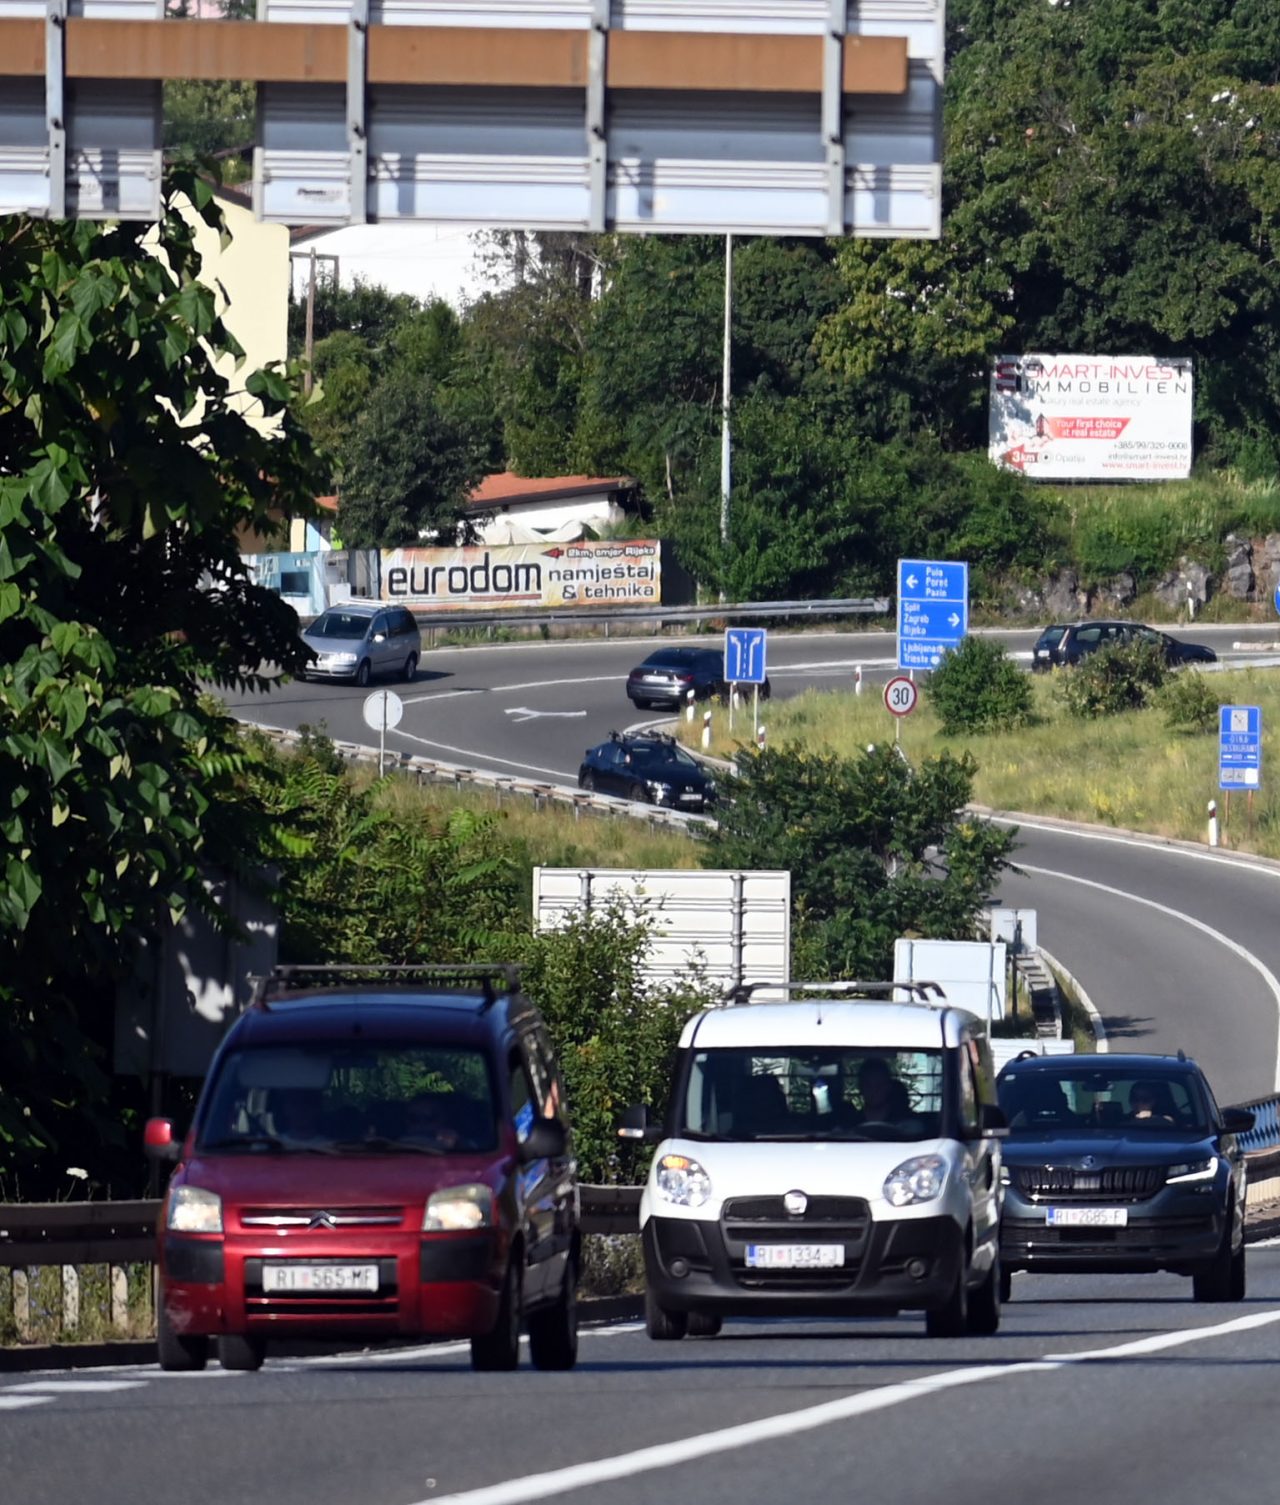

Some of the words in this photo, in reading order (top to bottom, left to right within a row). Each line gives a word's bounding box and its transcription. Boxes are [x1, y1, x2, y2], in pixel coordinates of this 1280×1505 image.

[1025, 381, 1187, 394] IMMOBILIEN
[1095, 419, 1122, 429] choice
[1089, 428, 1116, 437] estate
[388, 552, 542, 596] eurodom
[549, 561, 655, 583] namještaj
[562, 584, 577, 600] &
[584, 582, 654, 598] tehnika
[904, 613, 929, 625] Zagreb
[893, 687, 910, 705] 30
